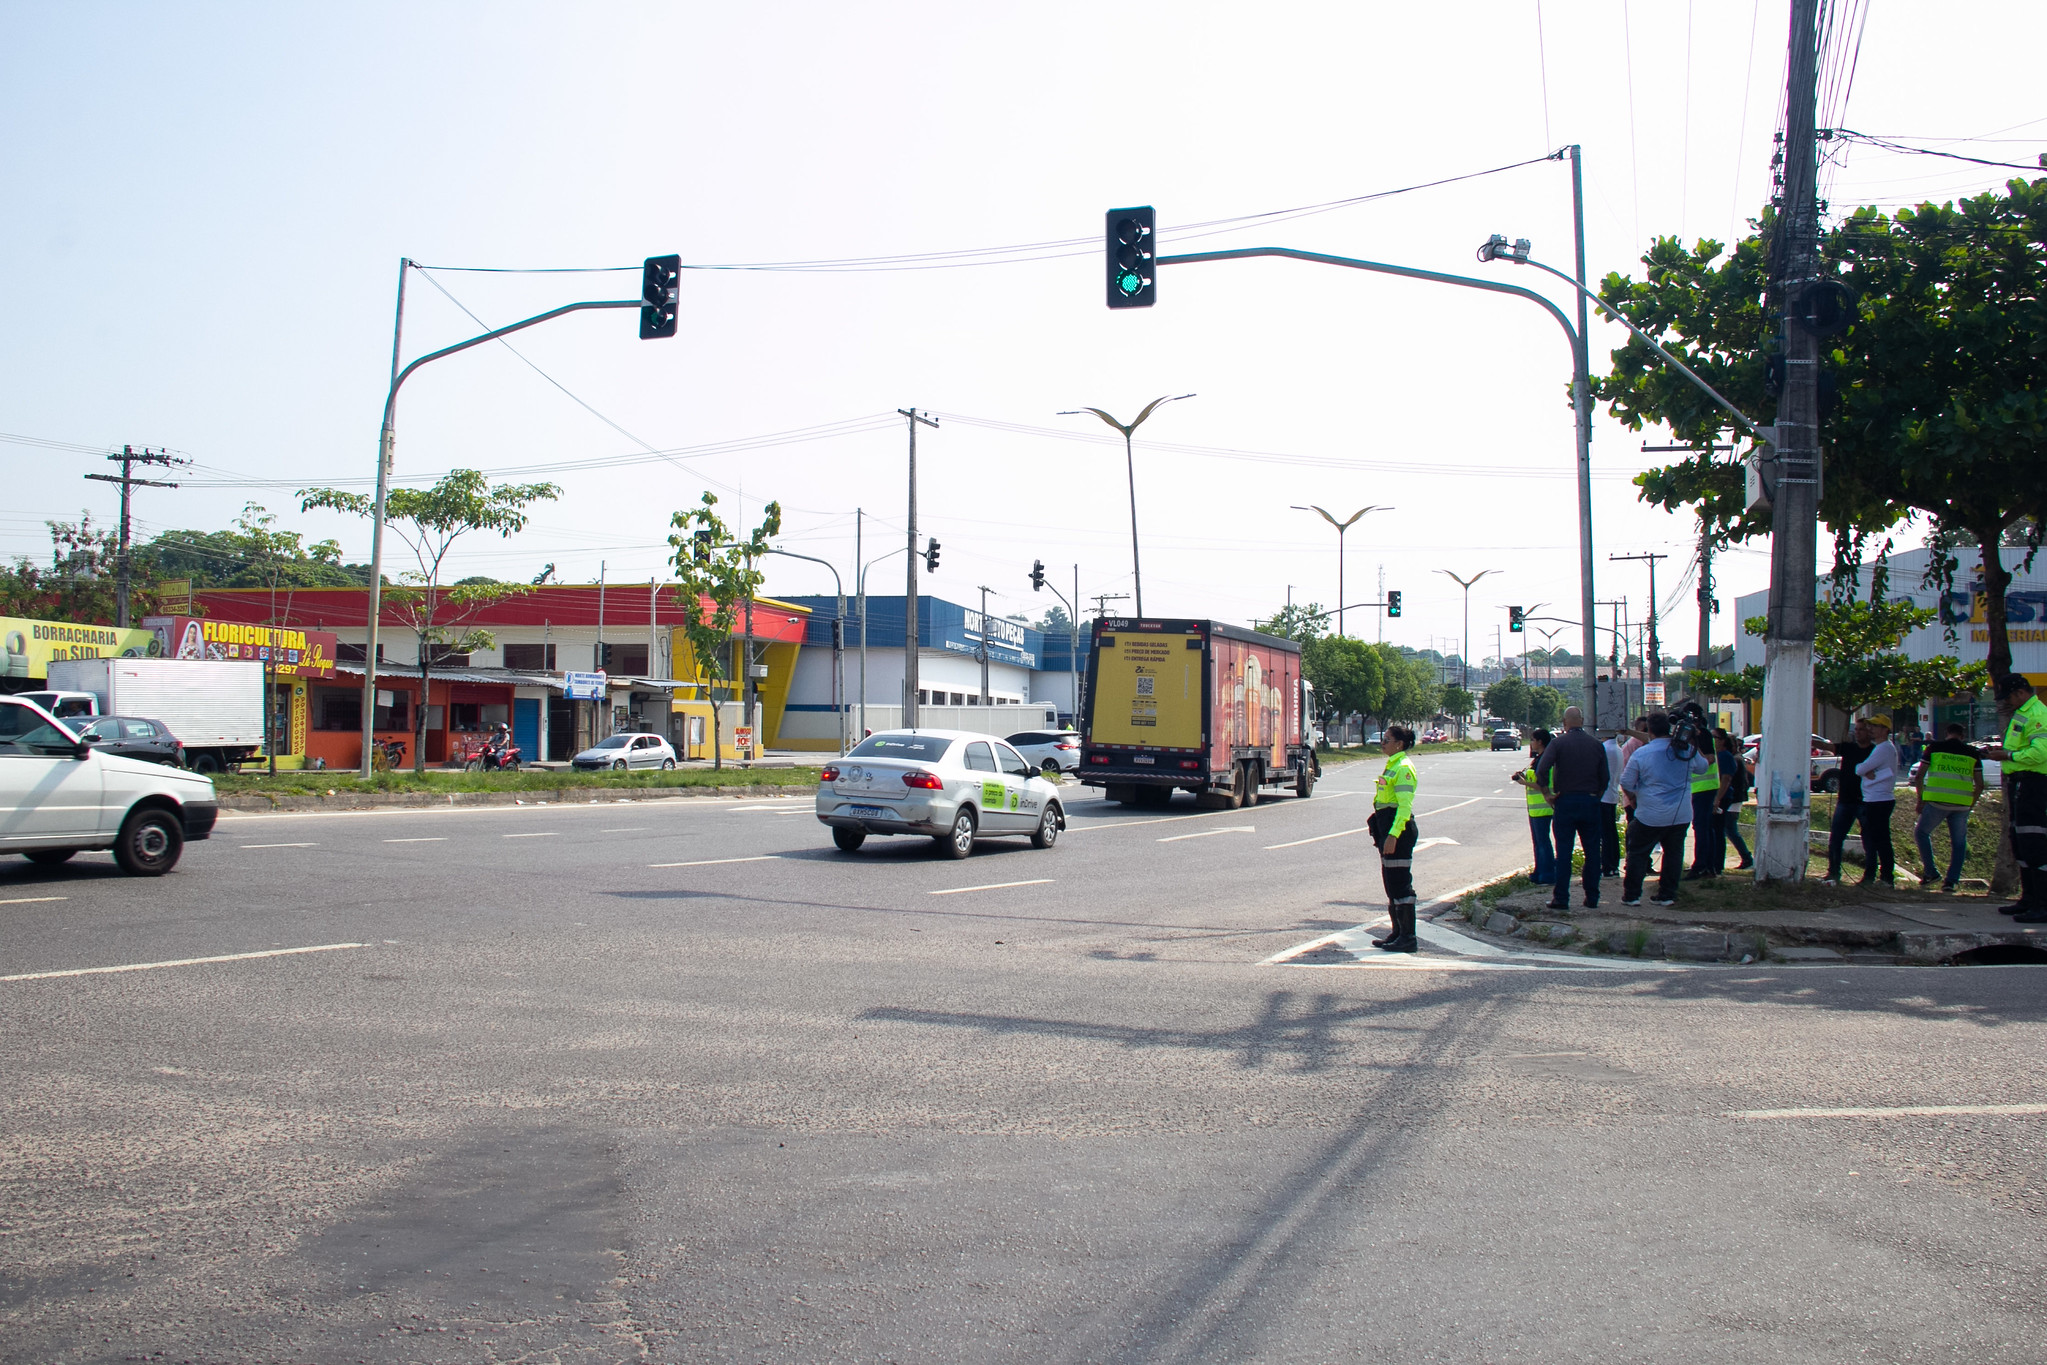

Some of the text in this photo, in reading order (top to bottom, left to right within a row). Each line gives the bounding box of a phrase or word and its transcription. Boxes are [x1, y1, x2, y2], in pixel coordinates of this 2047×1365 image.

[964, 609, 987, 634] NORT
[1109, 620, 1128, 628] VL049
[33, 624, 118, 646] BORRACHARIA
[203, 621, 306, 650] FLORICULTURA
[1971, 629, 2047, 642] MERIA
[53, 648, 68, 661] DO
[1020, 798, 1038, 808] inDrive
